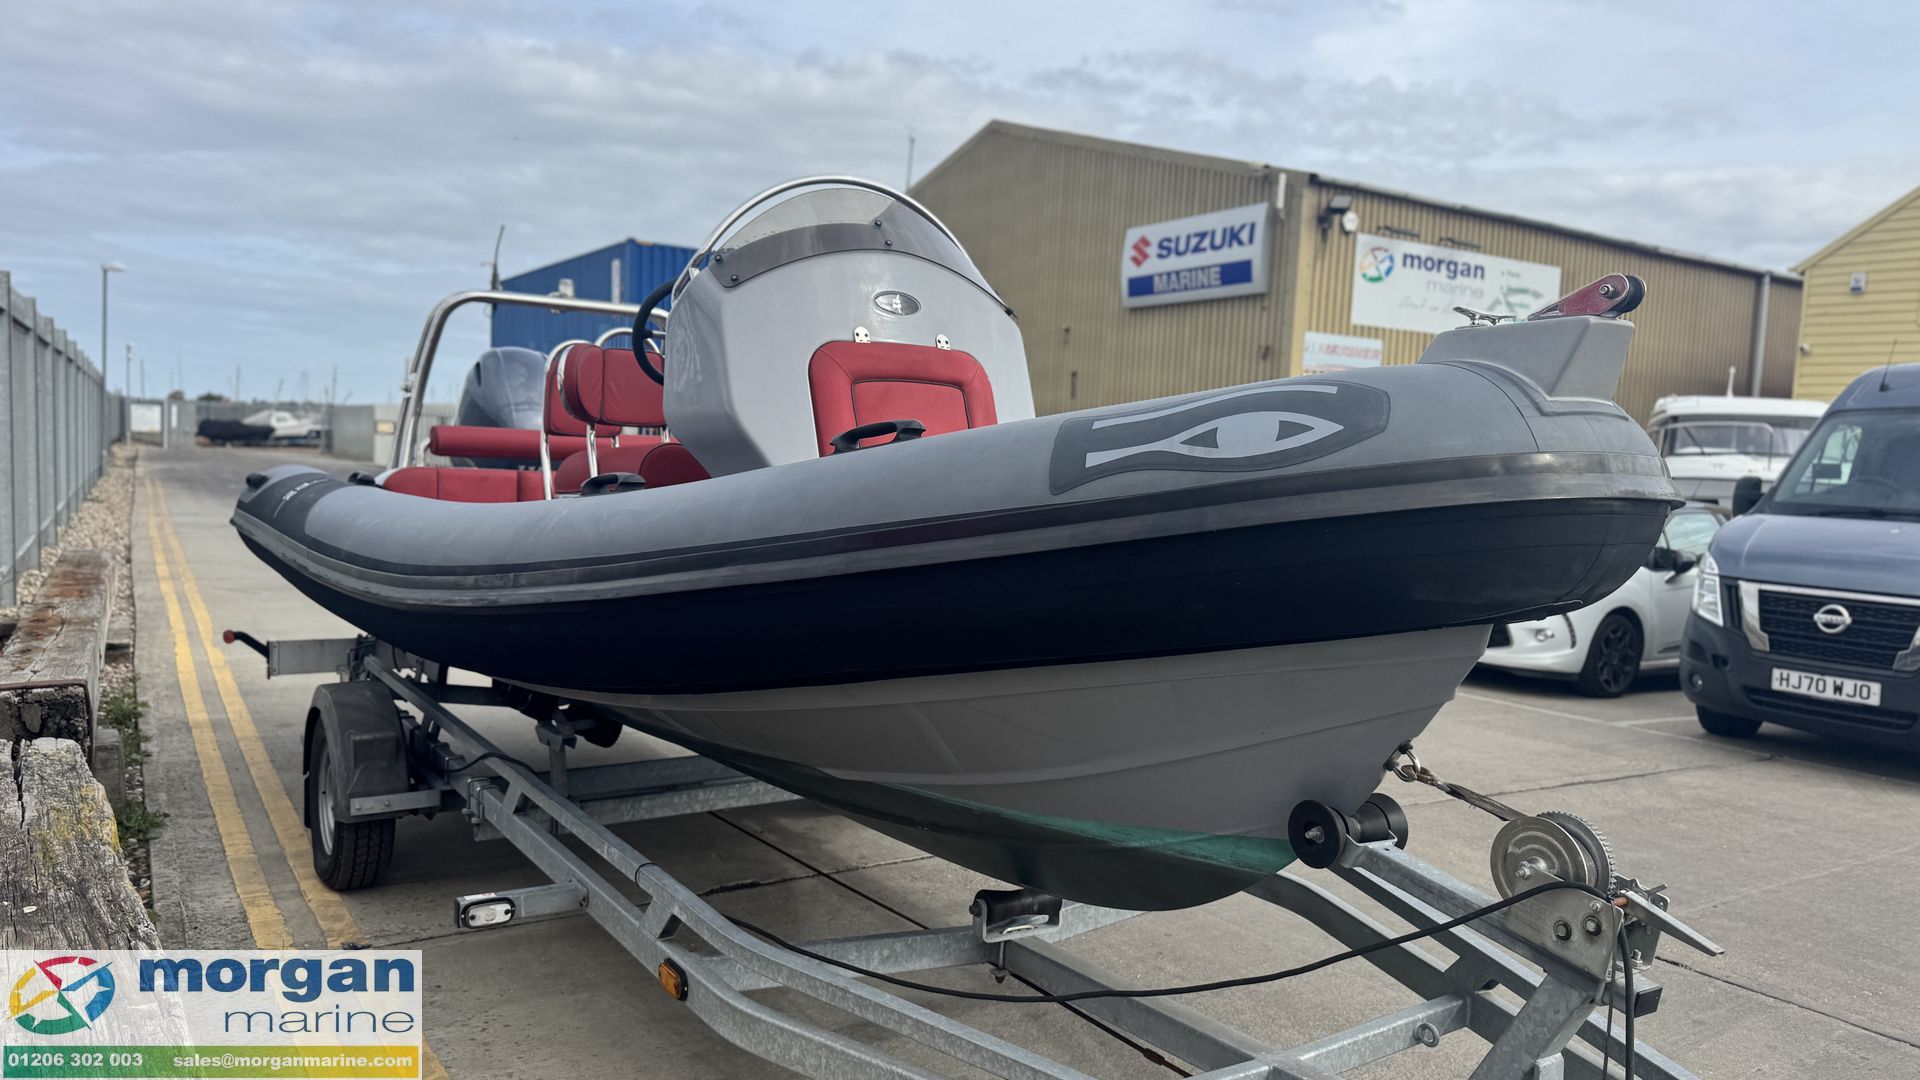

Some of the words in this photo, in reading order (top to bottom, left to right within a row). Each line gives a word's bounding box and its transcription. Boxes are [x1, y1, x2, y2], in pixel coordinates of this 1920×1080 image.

[1156, 221, 1256, 260] SUZUKI
[1153, 265, 1222, 294] MARINE
[1402, 252, 1486, 281] morgan
[1426, 279, 1485, 300] marine
[1779, 671, 1827, 694] HJ70
[1832, 680, 1871, 700] WJO
